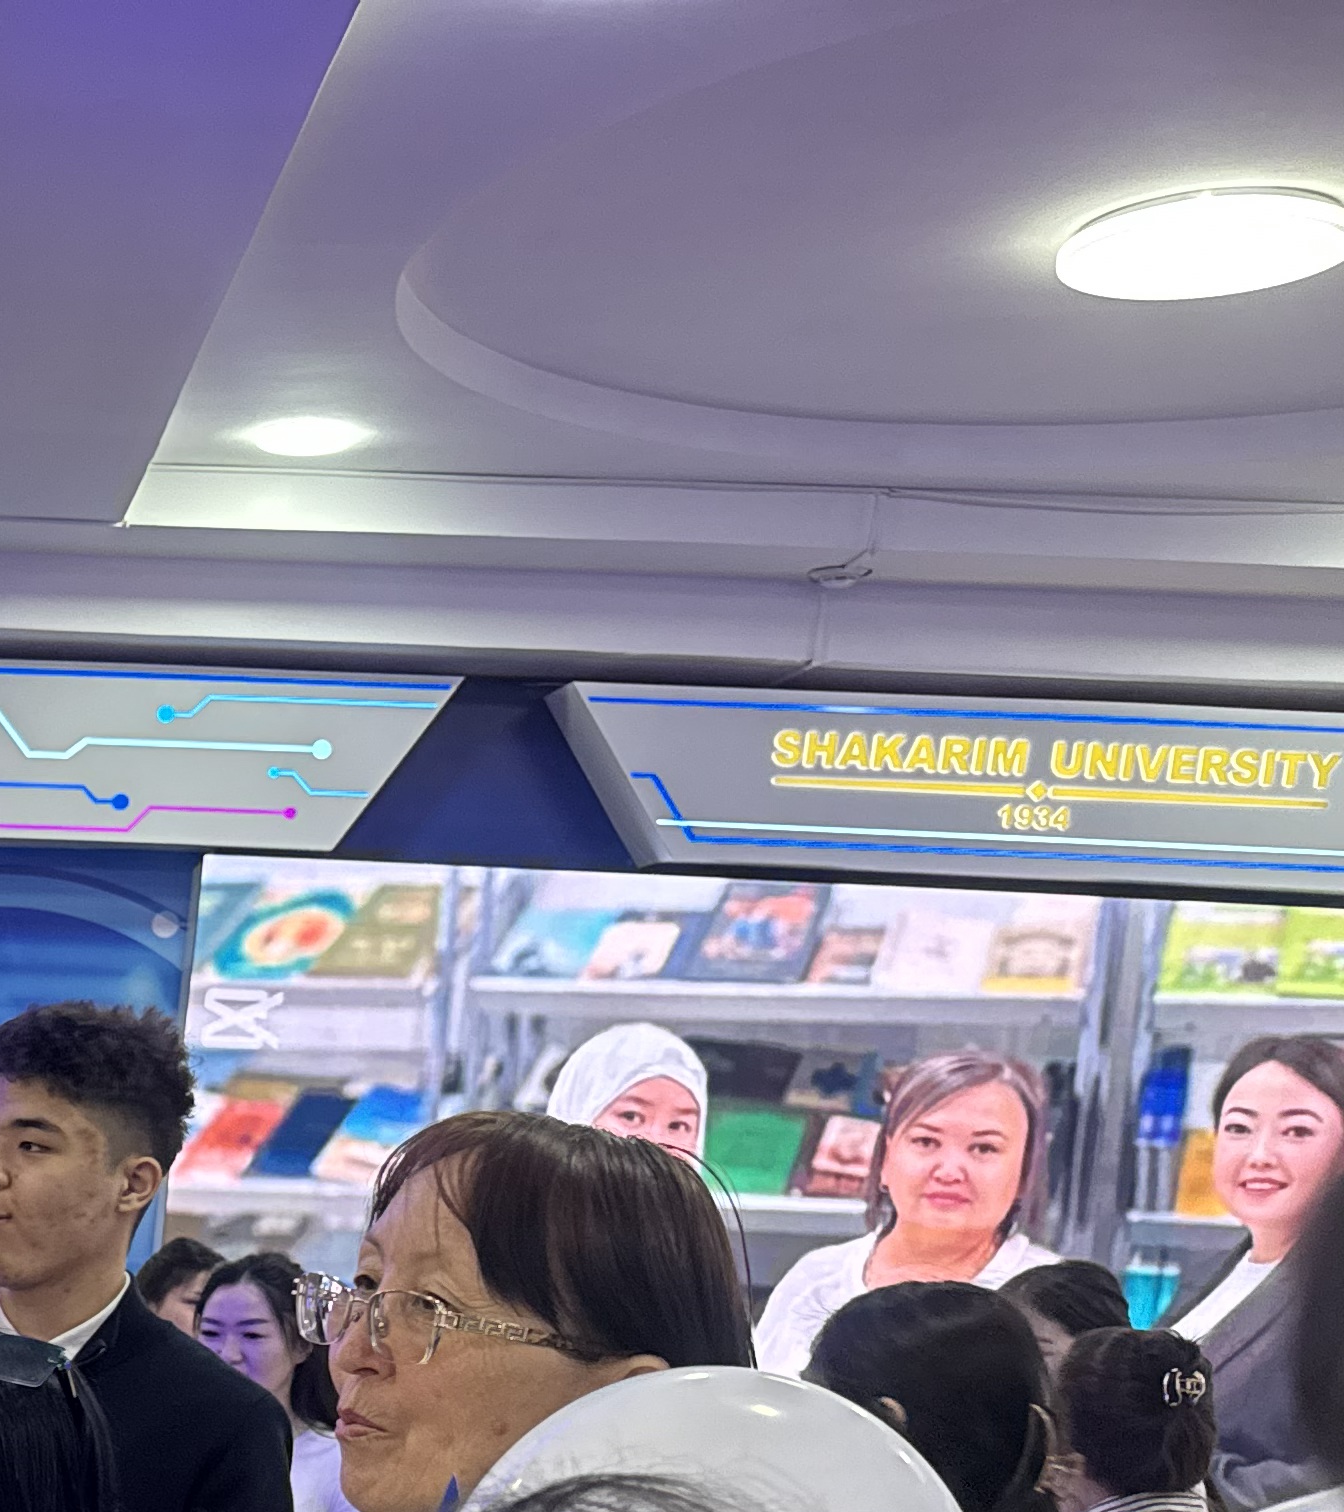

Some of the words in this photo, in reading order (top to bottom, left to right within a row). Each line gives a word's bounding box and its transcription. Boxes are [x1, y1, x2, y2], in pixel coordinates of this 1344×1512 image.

[771, 729, 1030, 777] SHAKARIM
[1050, 740, 1343, 789] UNIVERSITY
[996, 803, 1072, 832] 1934
